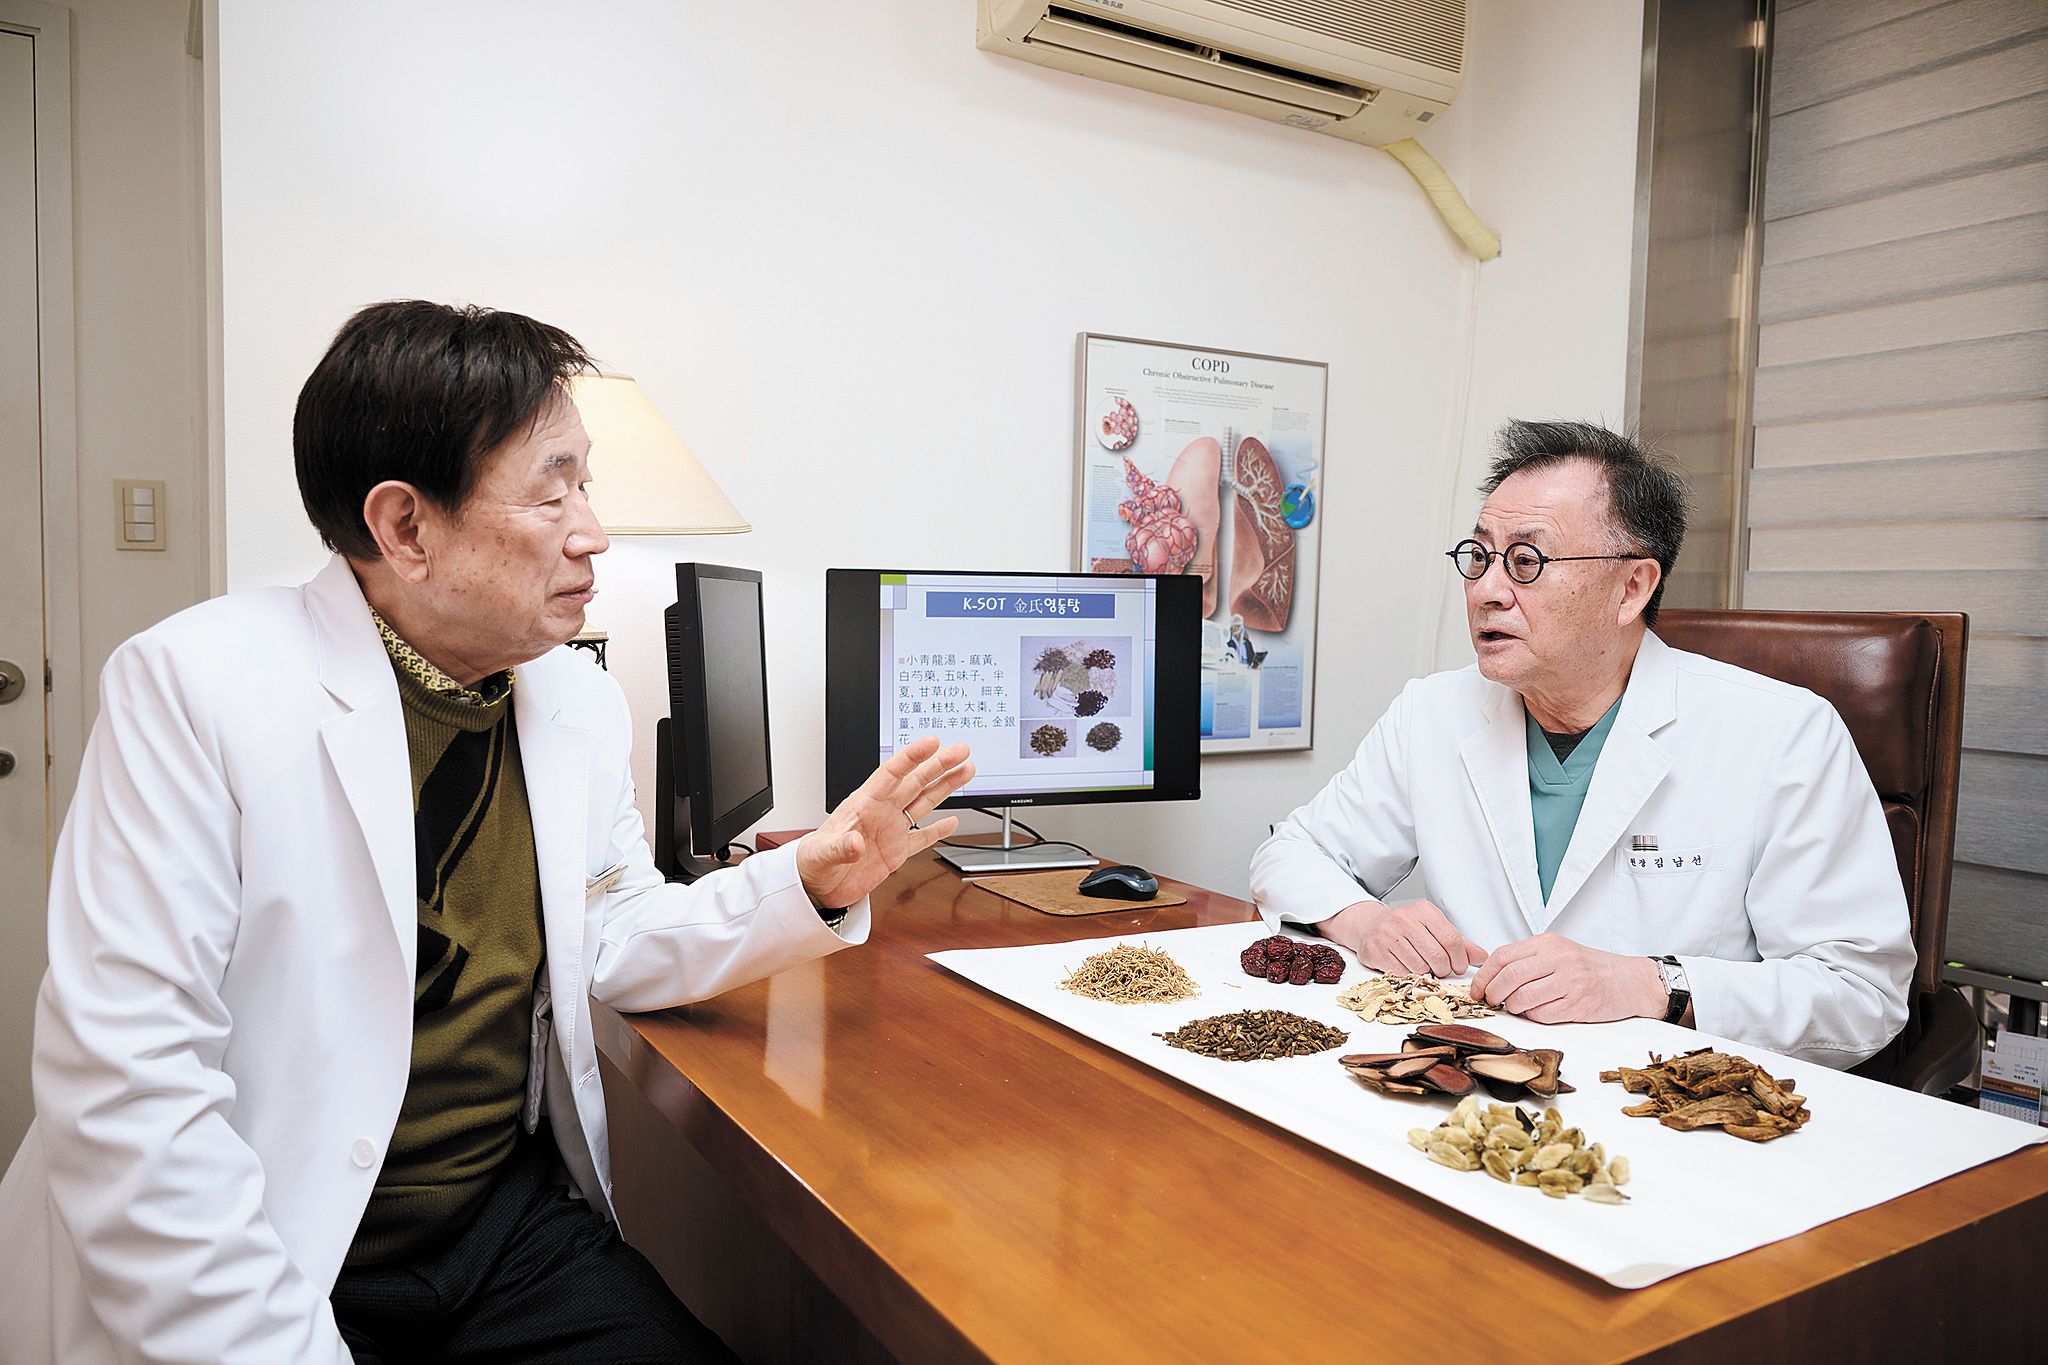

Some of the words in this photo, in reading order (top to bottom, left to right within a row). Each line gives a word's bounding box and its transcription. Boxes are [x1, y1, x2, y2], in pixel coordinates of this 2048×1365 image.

[1192, 357, 1230, 373] COPD
[1143, 368, 1171, 379] Chronic
[1172, 371, 1211, 384] Obstructive
[1213, 376, 1248, 389] Pulmonary
[1250, 380, 1275, 390] Disease
[963, 597, 1007, 611] K-SOT
[996, 701, 1007, 713] 生
